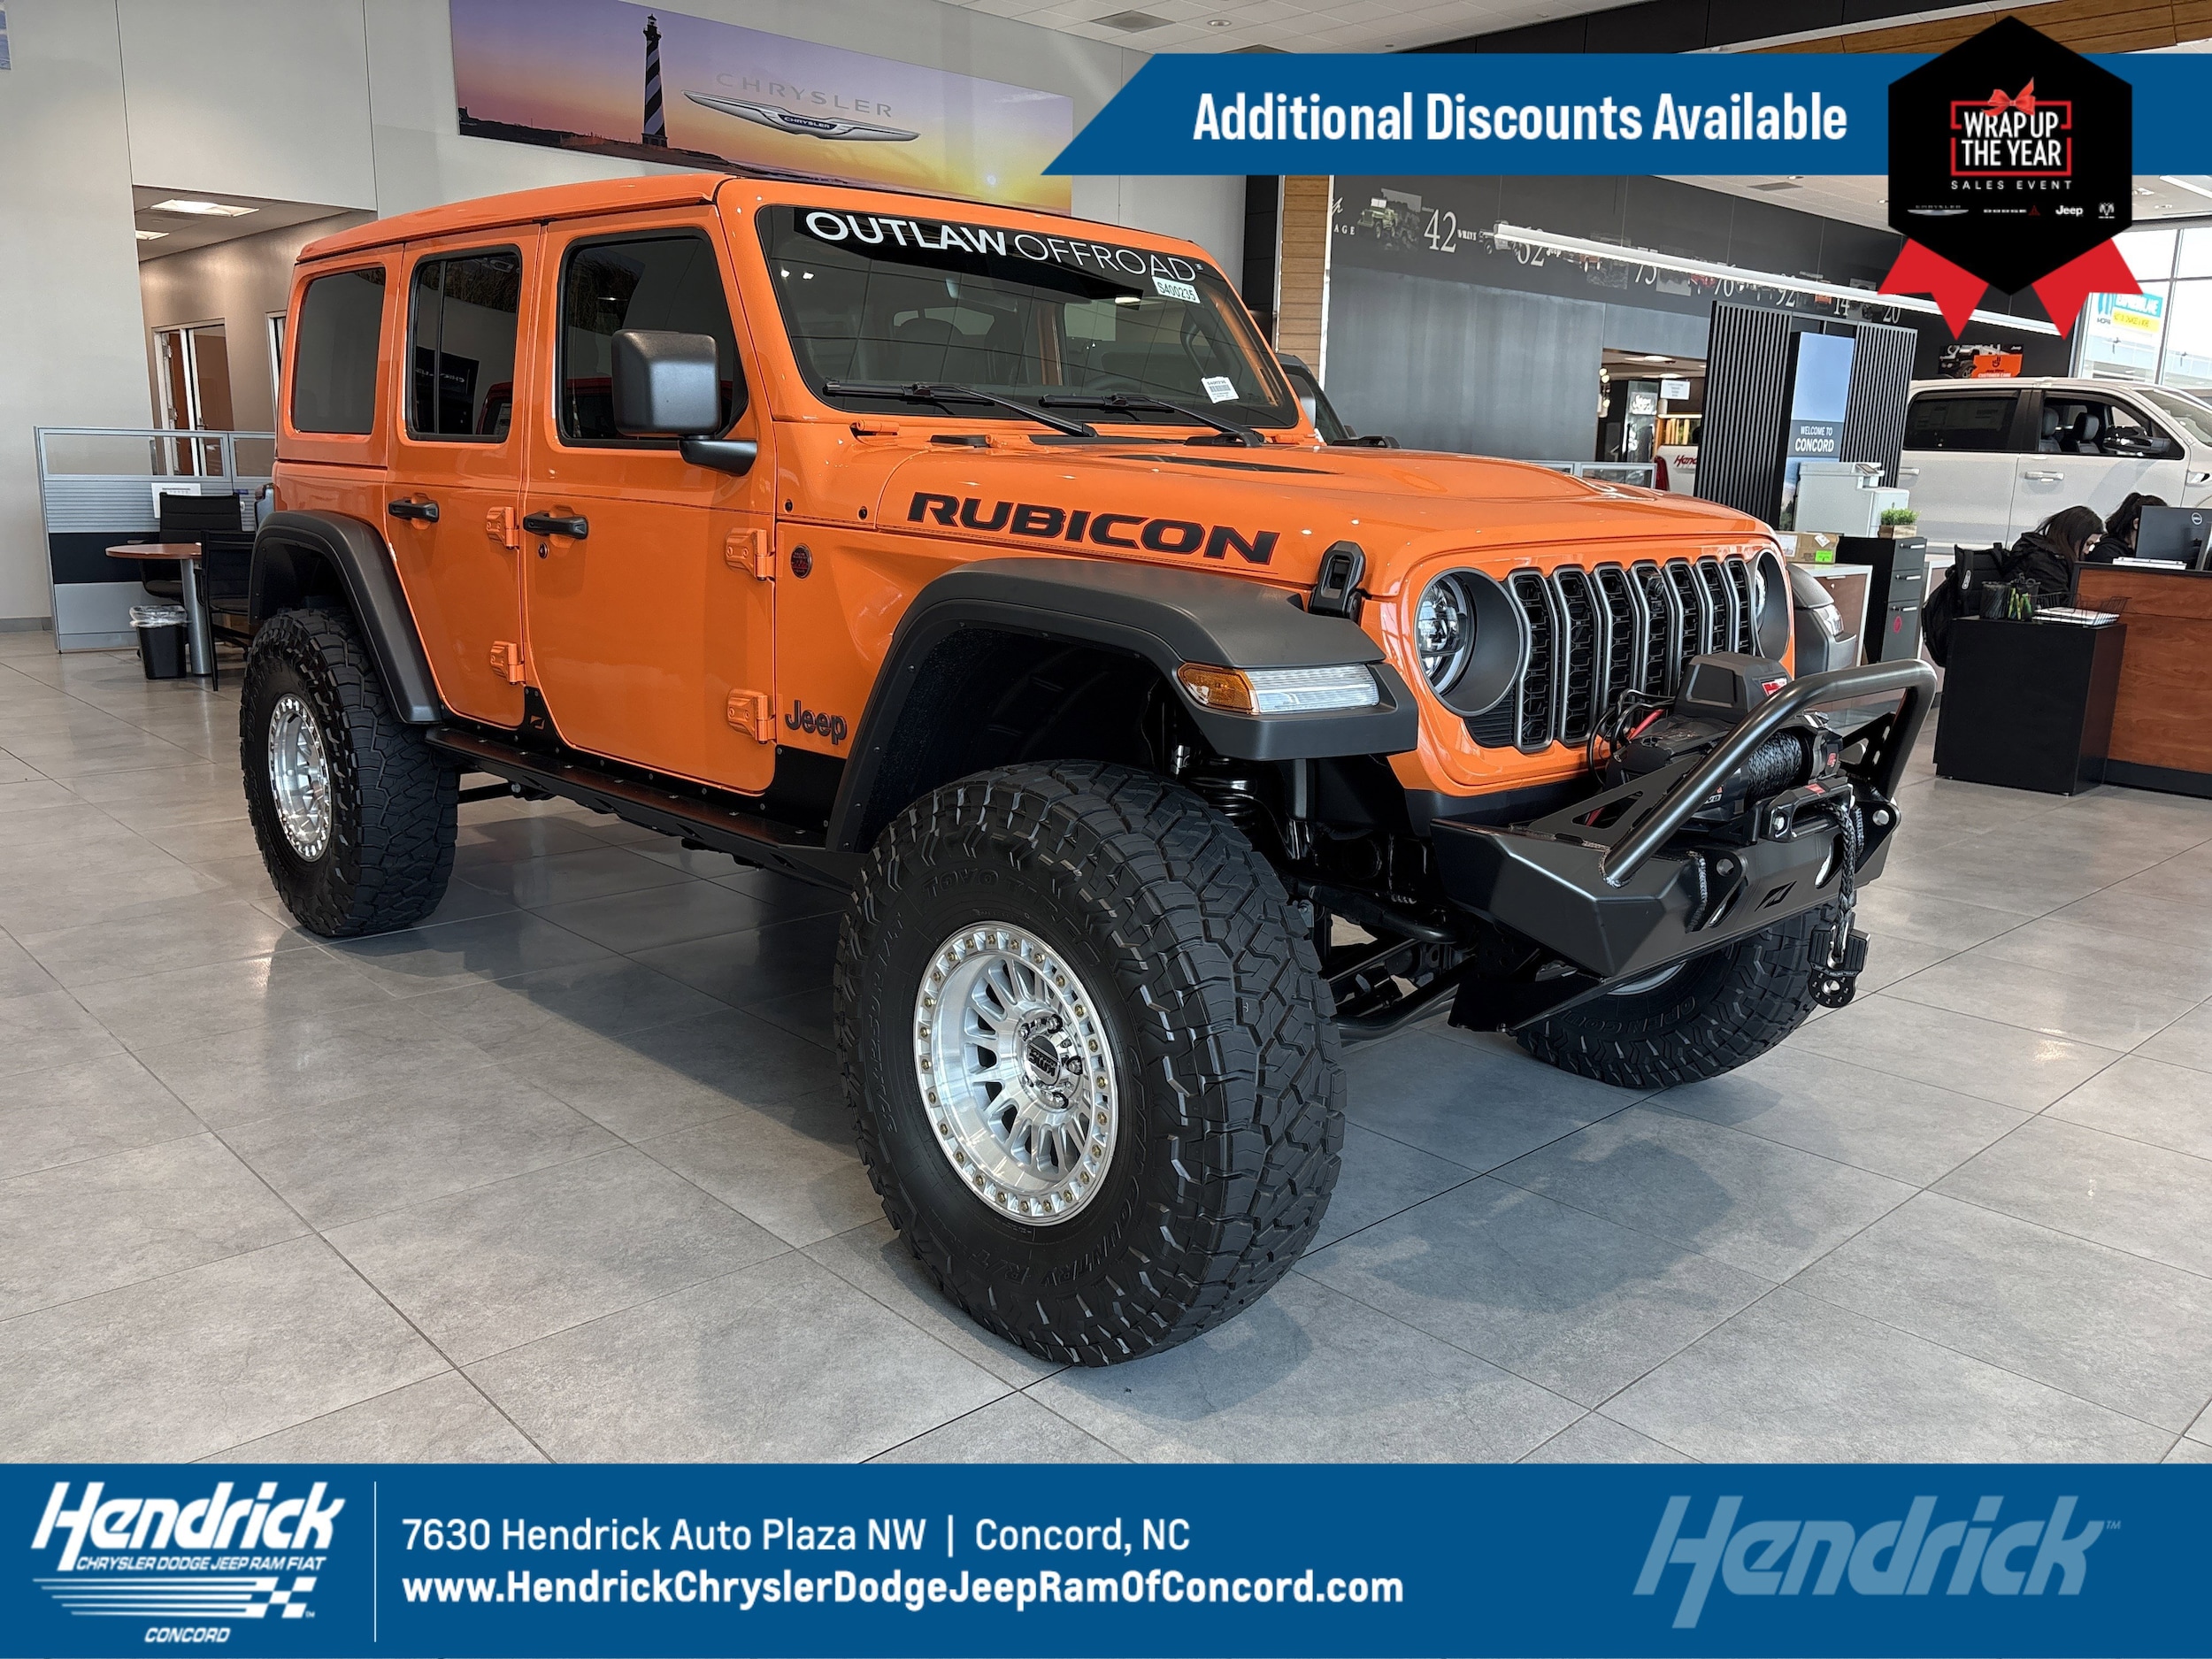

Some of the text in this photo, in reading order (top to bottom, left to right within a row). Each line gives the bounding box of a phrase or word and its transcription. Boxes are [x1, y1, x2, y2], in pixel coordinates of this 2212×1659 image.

[716, 73, 892, 118] CHRYSLER
[783, 116, 831, 129] CHRYSLER
[805, 211, 1197, 281] OUTLAW OFFROAD
[1424, 208, 1457, 254] 42
[1157, 281, 1196, 301] S400235
[1794, 437, 1835, 453] CONCORD
[1800, 426, 1833, 436] WELCOME TO
[906, 491, 1281, 565] RUBICON
[785, 700, 847, 745] Jeep
